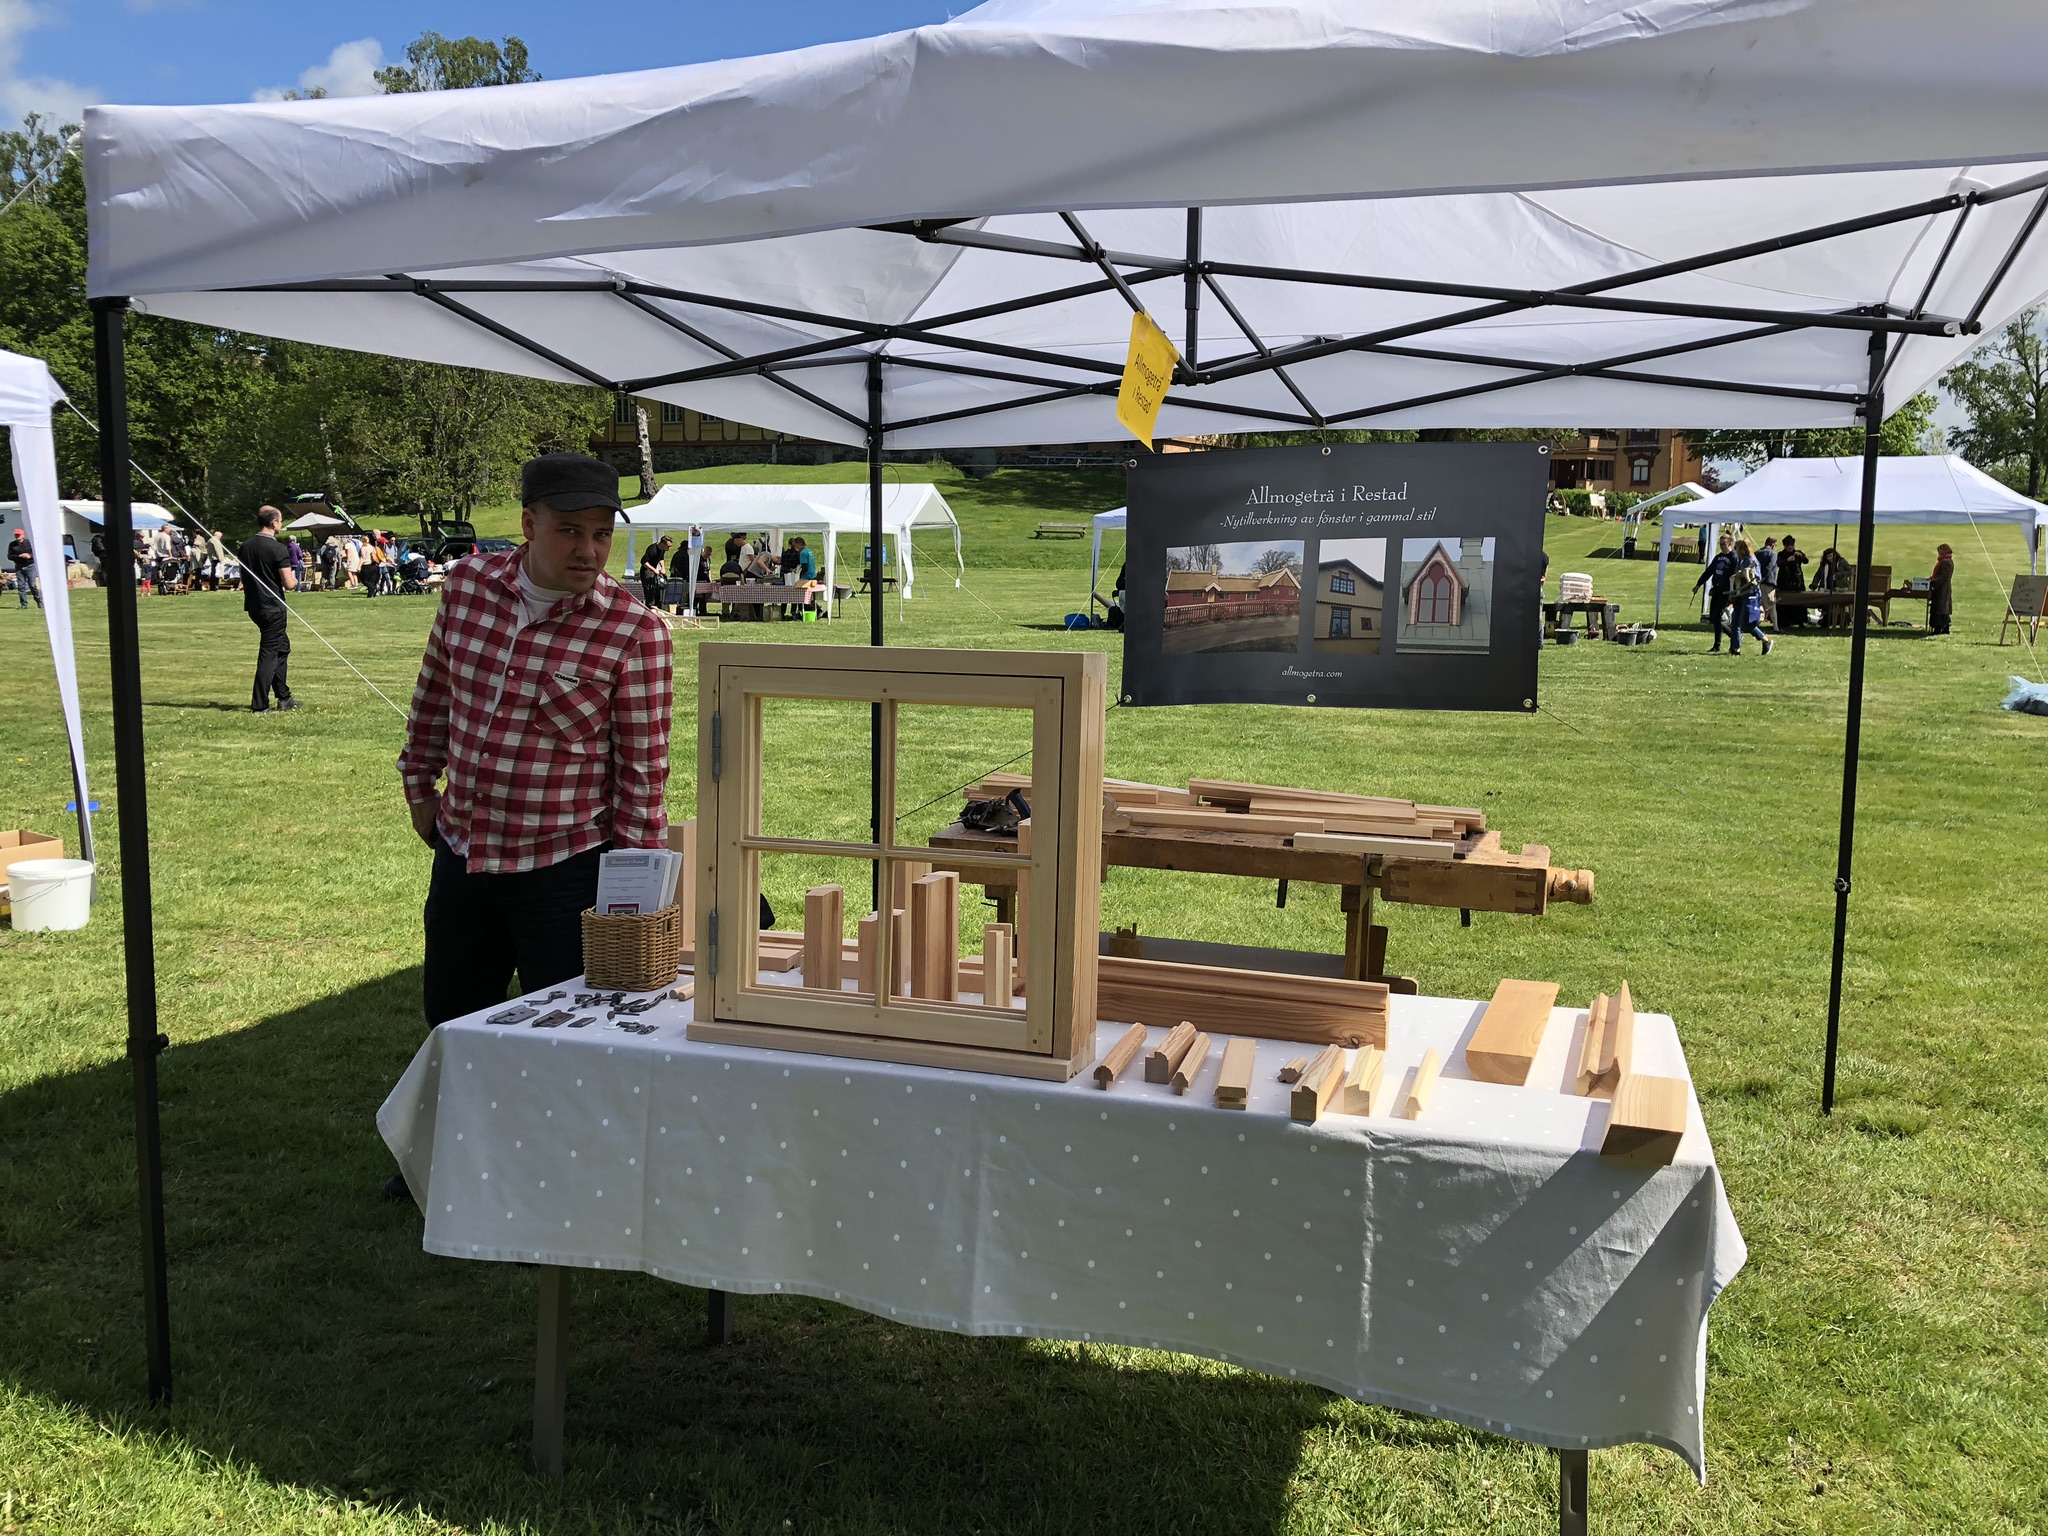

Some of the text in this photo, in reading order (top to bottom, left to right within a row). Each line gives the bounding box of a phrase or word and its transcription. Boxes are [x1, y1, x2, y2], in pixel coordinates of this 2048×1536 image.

[1135, 386, 1153, 414] Restad
[1245, 481, 1408, 507] Allmogeträ i Restad
[1220, 506, 1437, 530] -Nytillverkning av fönster i gammal stil
[1281, 665, 1343, 680] allmogetra.com
